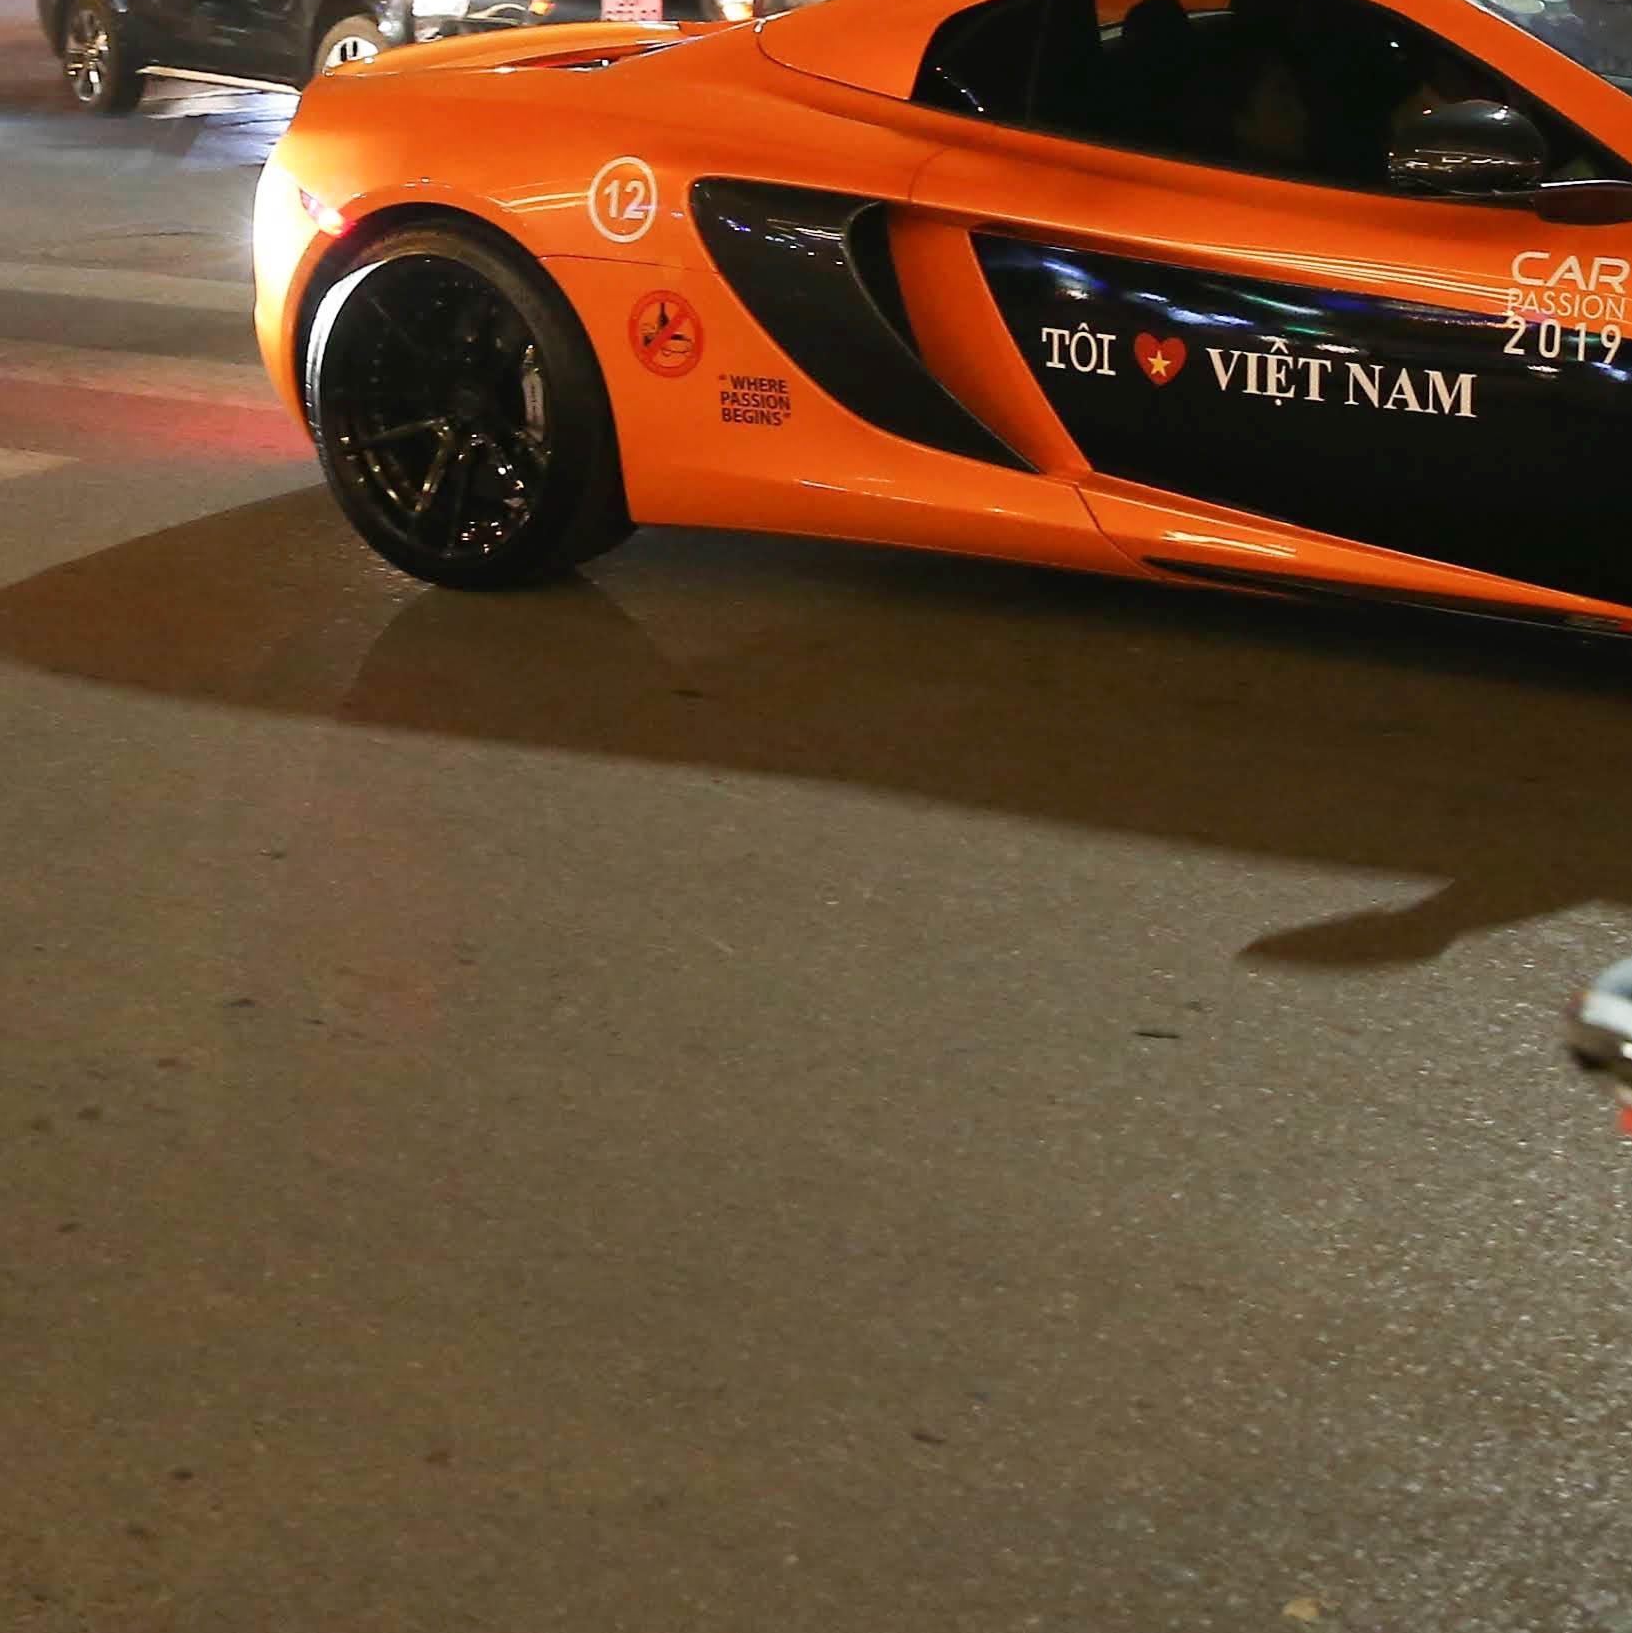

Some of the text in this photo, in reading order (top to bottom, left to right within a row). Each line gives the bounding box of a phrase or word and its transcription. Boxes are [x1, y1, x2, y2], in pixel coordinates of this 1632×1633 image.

[602, 179, 647, 220] 12
[1511, 251, 1631, 294] CAR
[1507, 287, 1626, 321] PASSION
[1503, 314, 1623, 364] 2019
[1041, 321, 1479, 418] TÔI VIỆT NAM
[720, 391, 792, 410] PASSION
